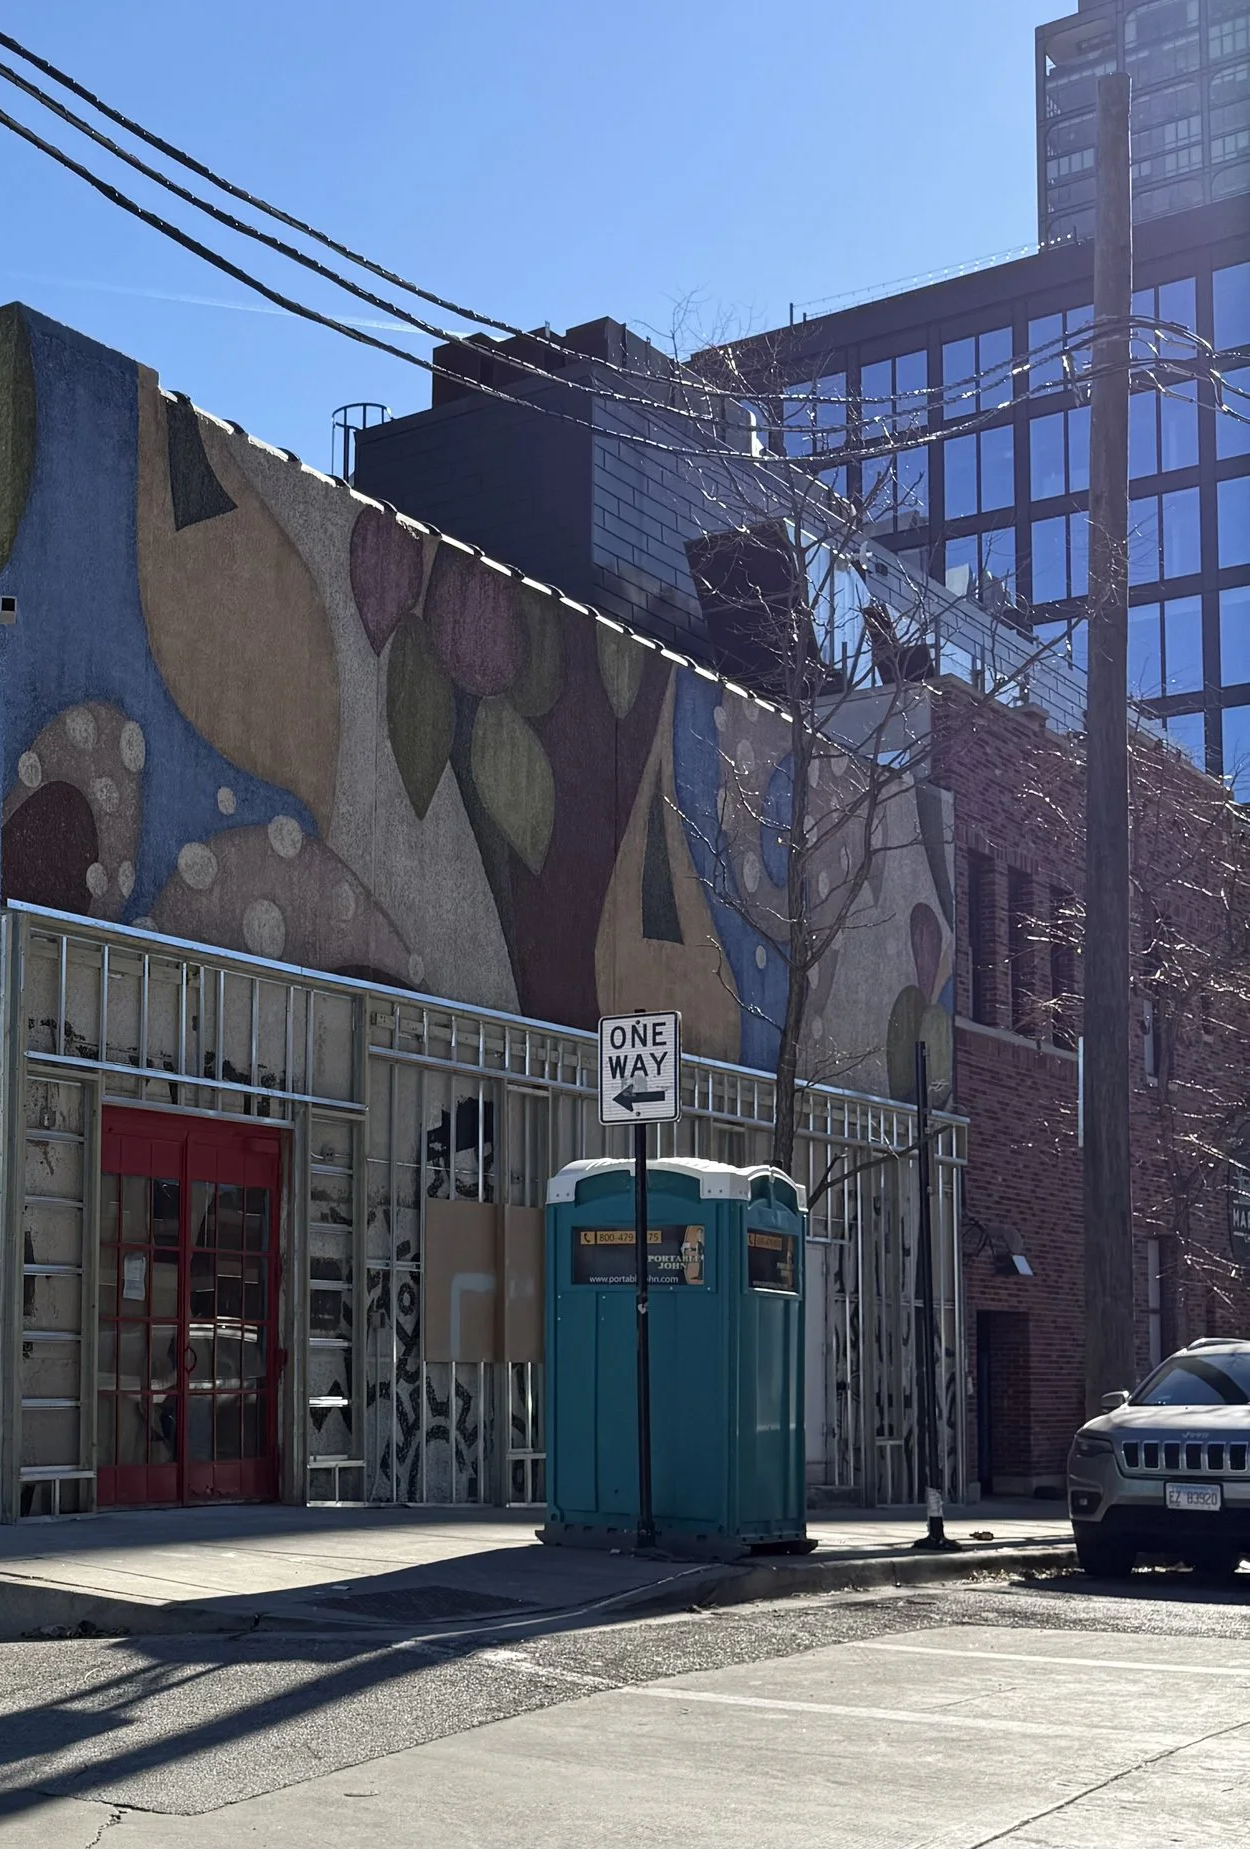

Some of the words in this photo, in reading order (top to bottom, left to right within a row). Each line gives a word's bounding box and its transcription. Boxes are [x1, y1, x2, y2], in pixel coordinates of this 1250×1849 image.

[610, 1022, 667, 1049] ONE
[608, 1051, 668, 1079] WAY
[647, 1254, 701, 1263] PORTABLE
[658, 1262, 687, 1270] JOHN
[589, 1274, 679, 1285] www.portablhn.com
[1169, 1490, 1181, 1504] EZ
